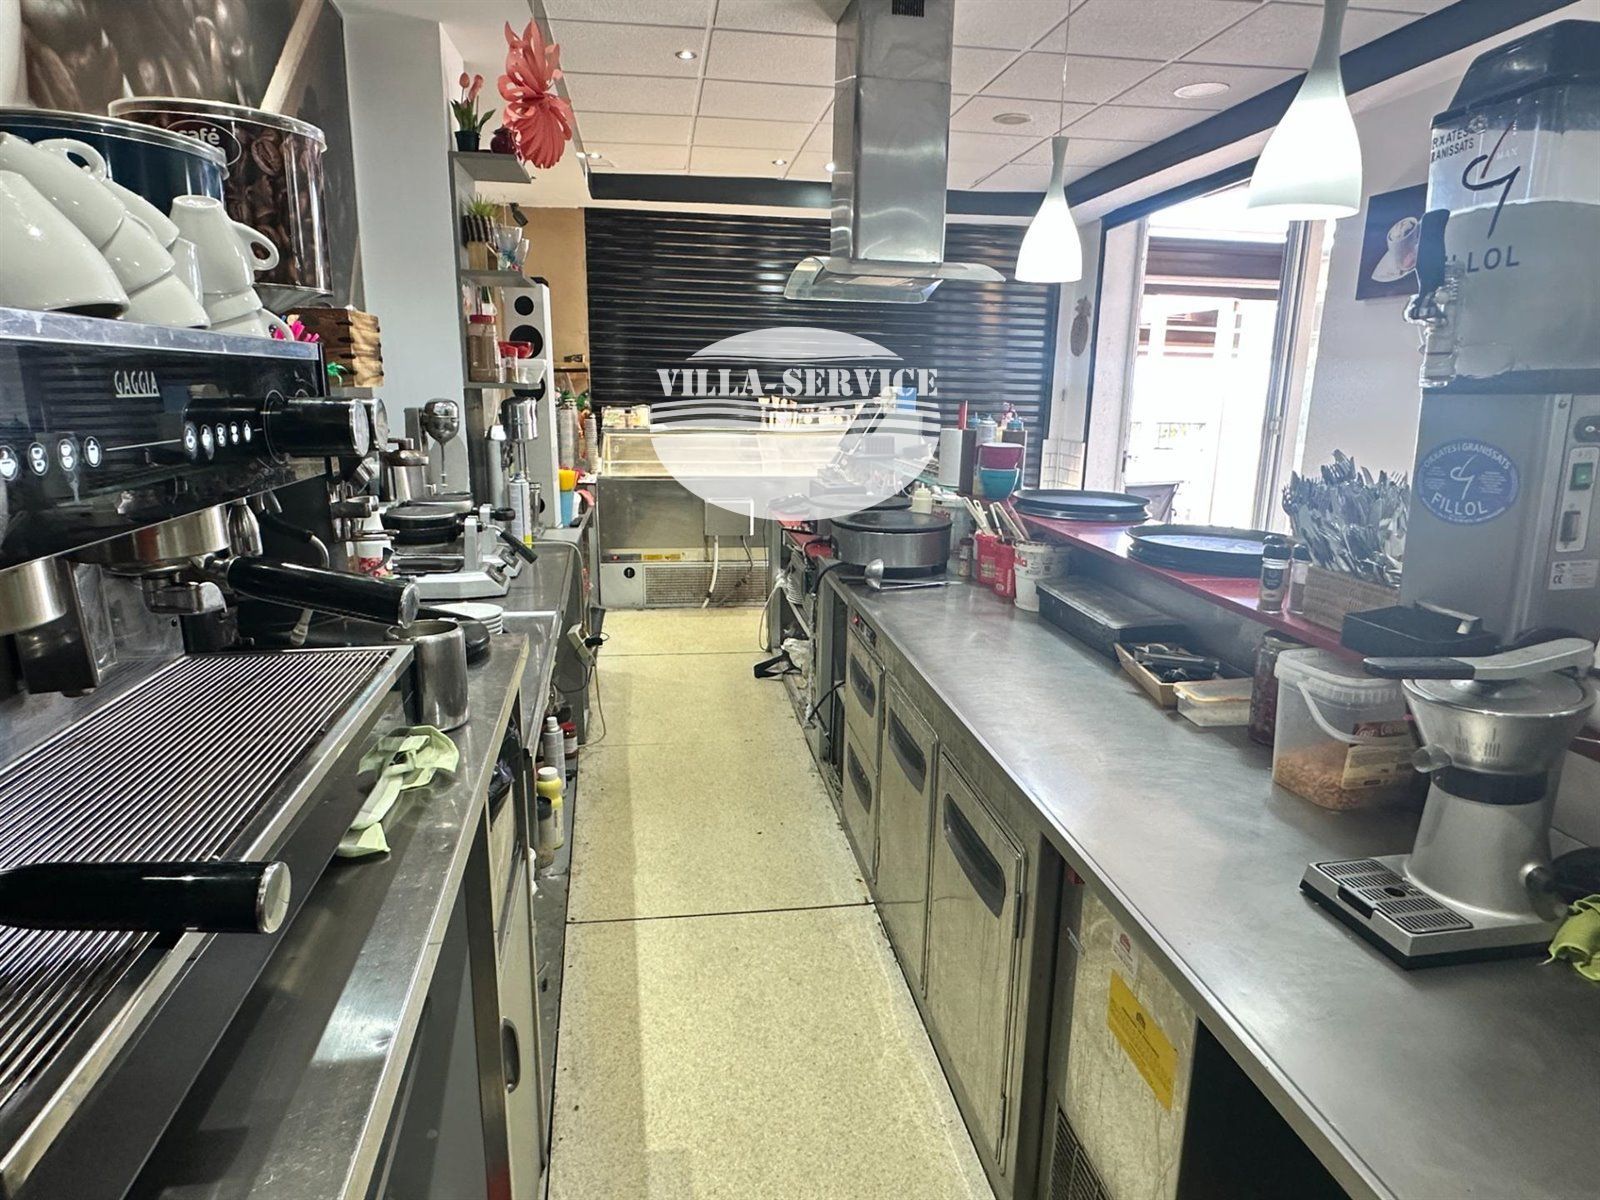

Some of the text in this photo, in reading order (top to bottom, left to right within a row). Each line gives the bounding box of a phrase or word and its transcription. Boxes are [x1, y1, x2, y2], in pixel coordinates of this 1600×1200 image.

[1432, 126, 1469, 148] RXATES
[114, 370, 160, 396] GAGGIA
[1430, 491, 1489, 516] FILLOL
